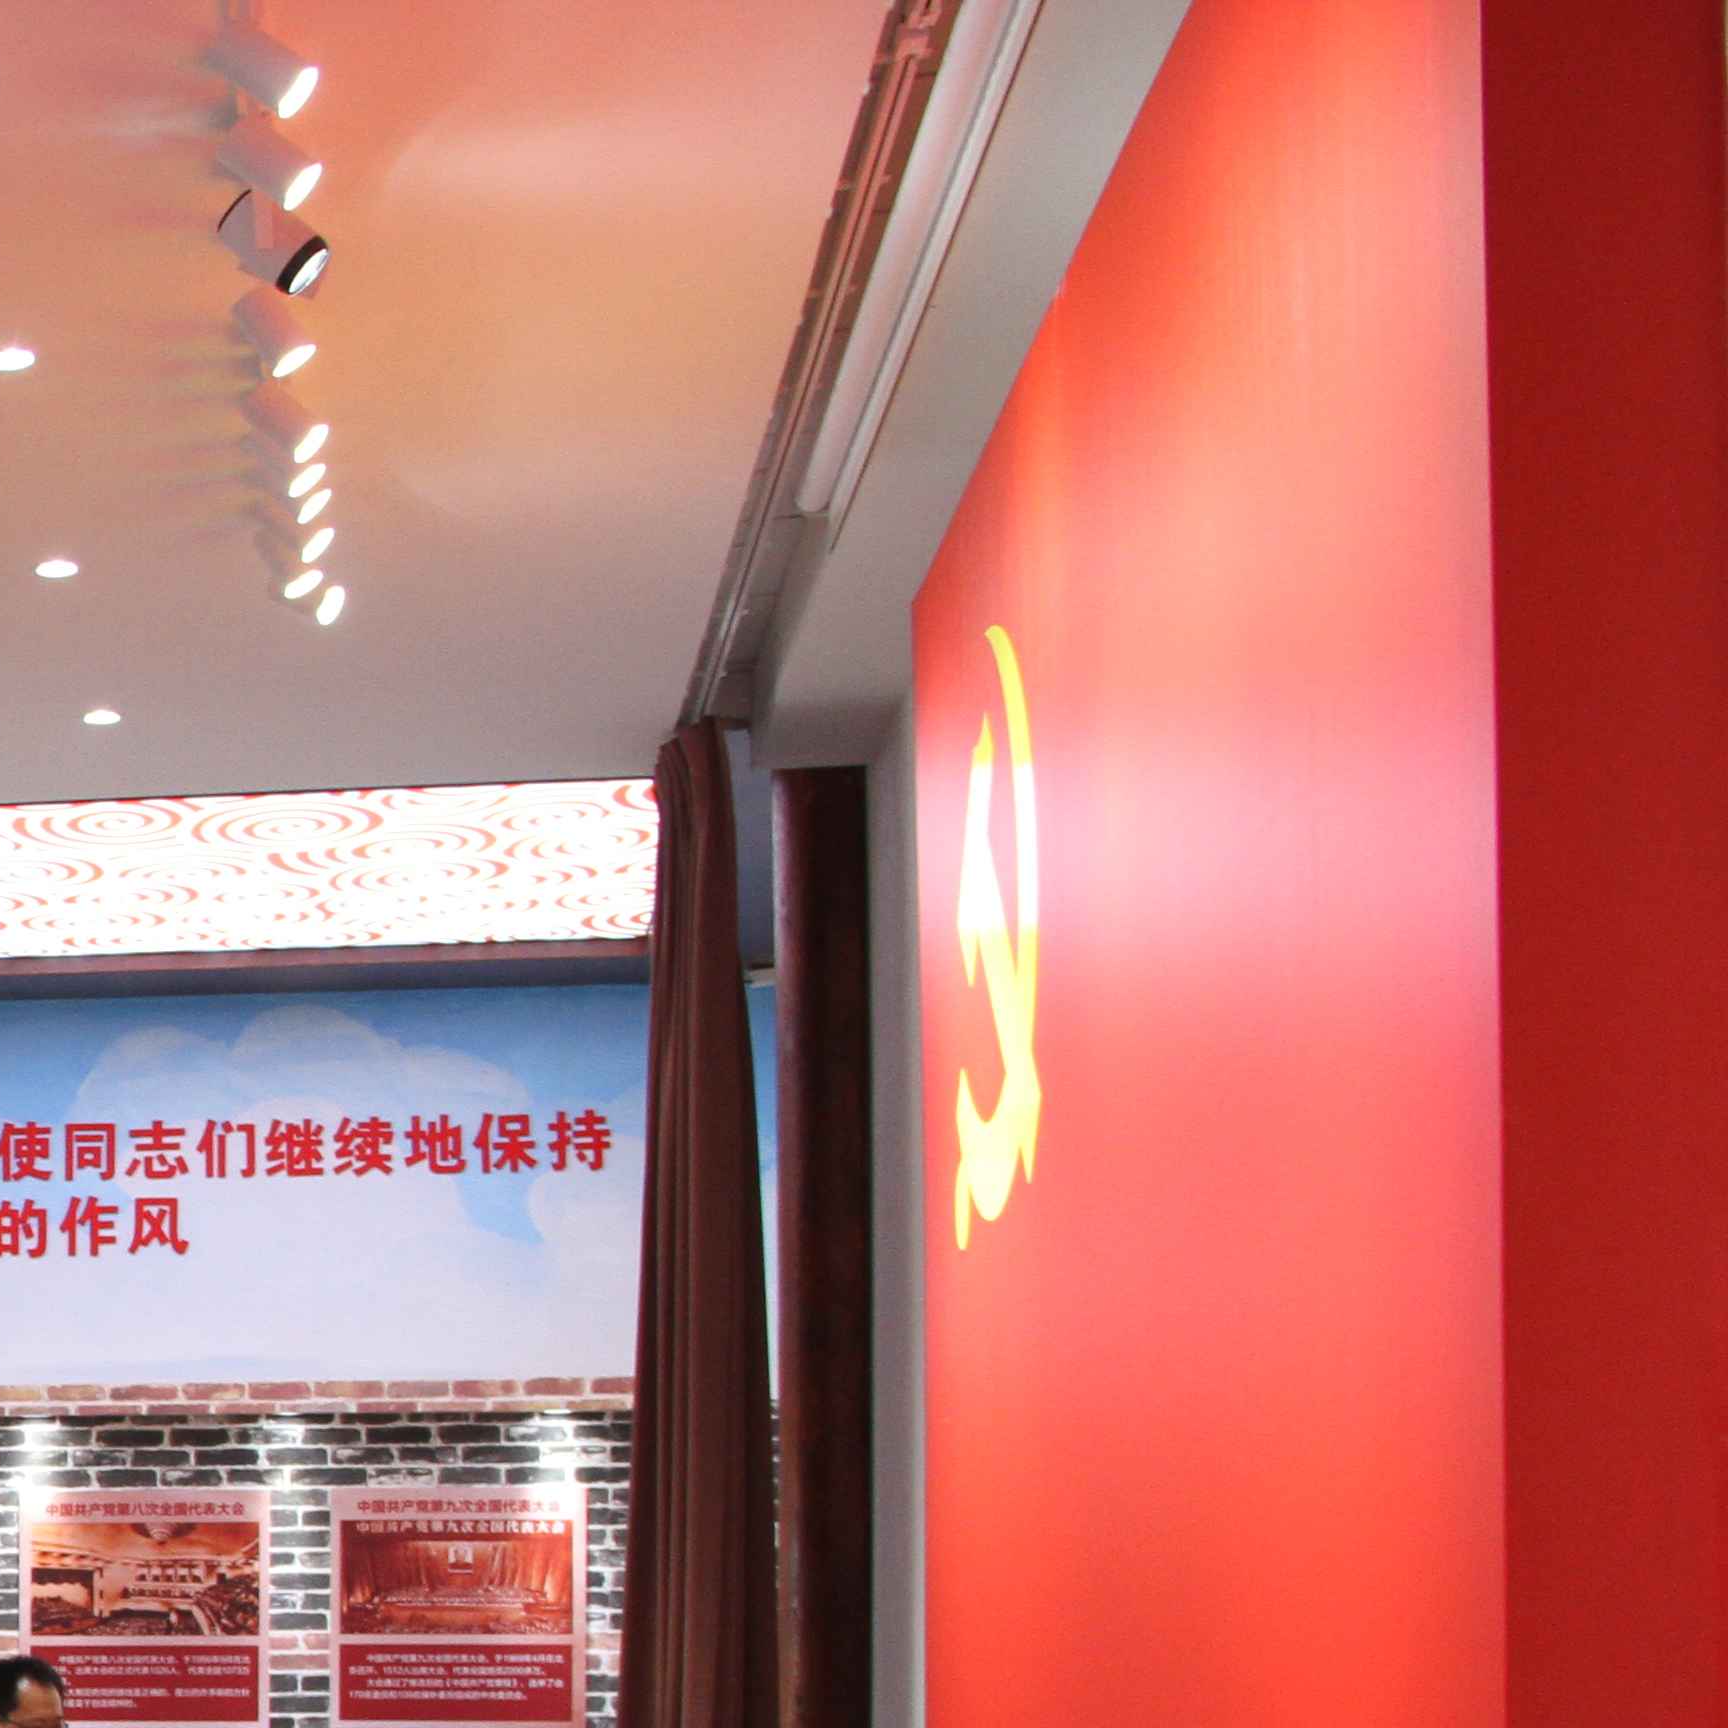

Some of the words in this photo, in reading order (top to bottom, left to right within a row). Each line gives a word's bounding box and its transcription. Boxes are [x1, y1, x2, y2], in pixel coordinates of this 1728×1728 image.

[46, 1502, 245, 1517] 中国共产党第八次全国代表大会
